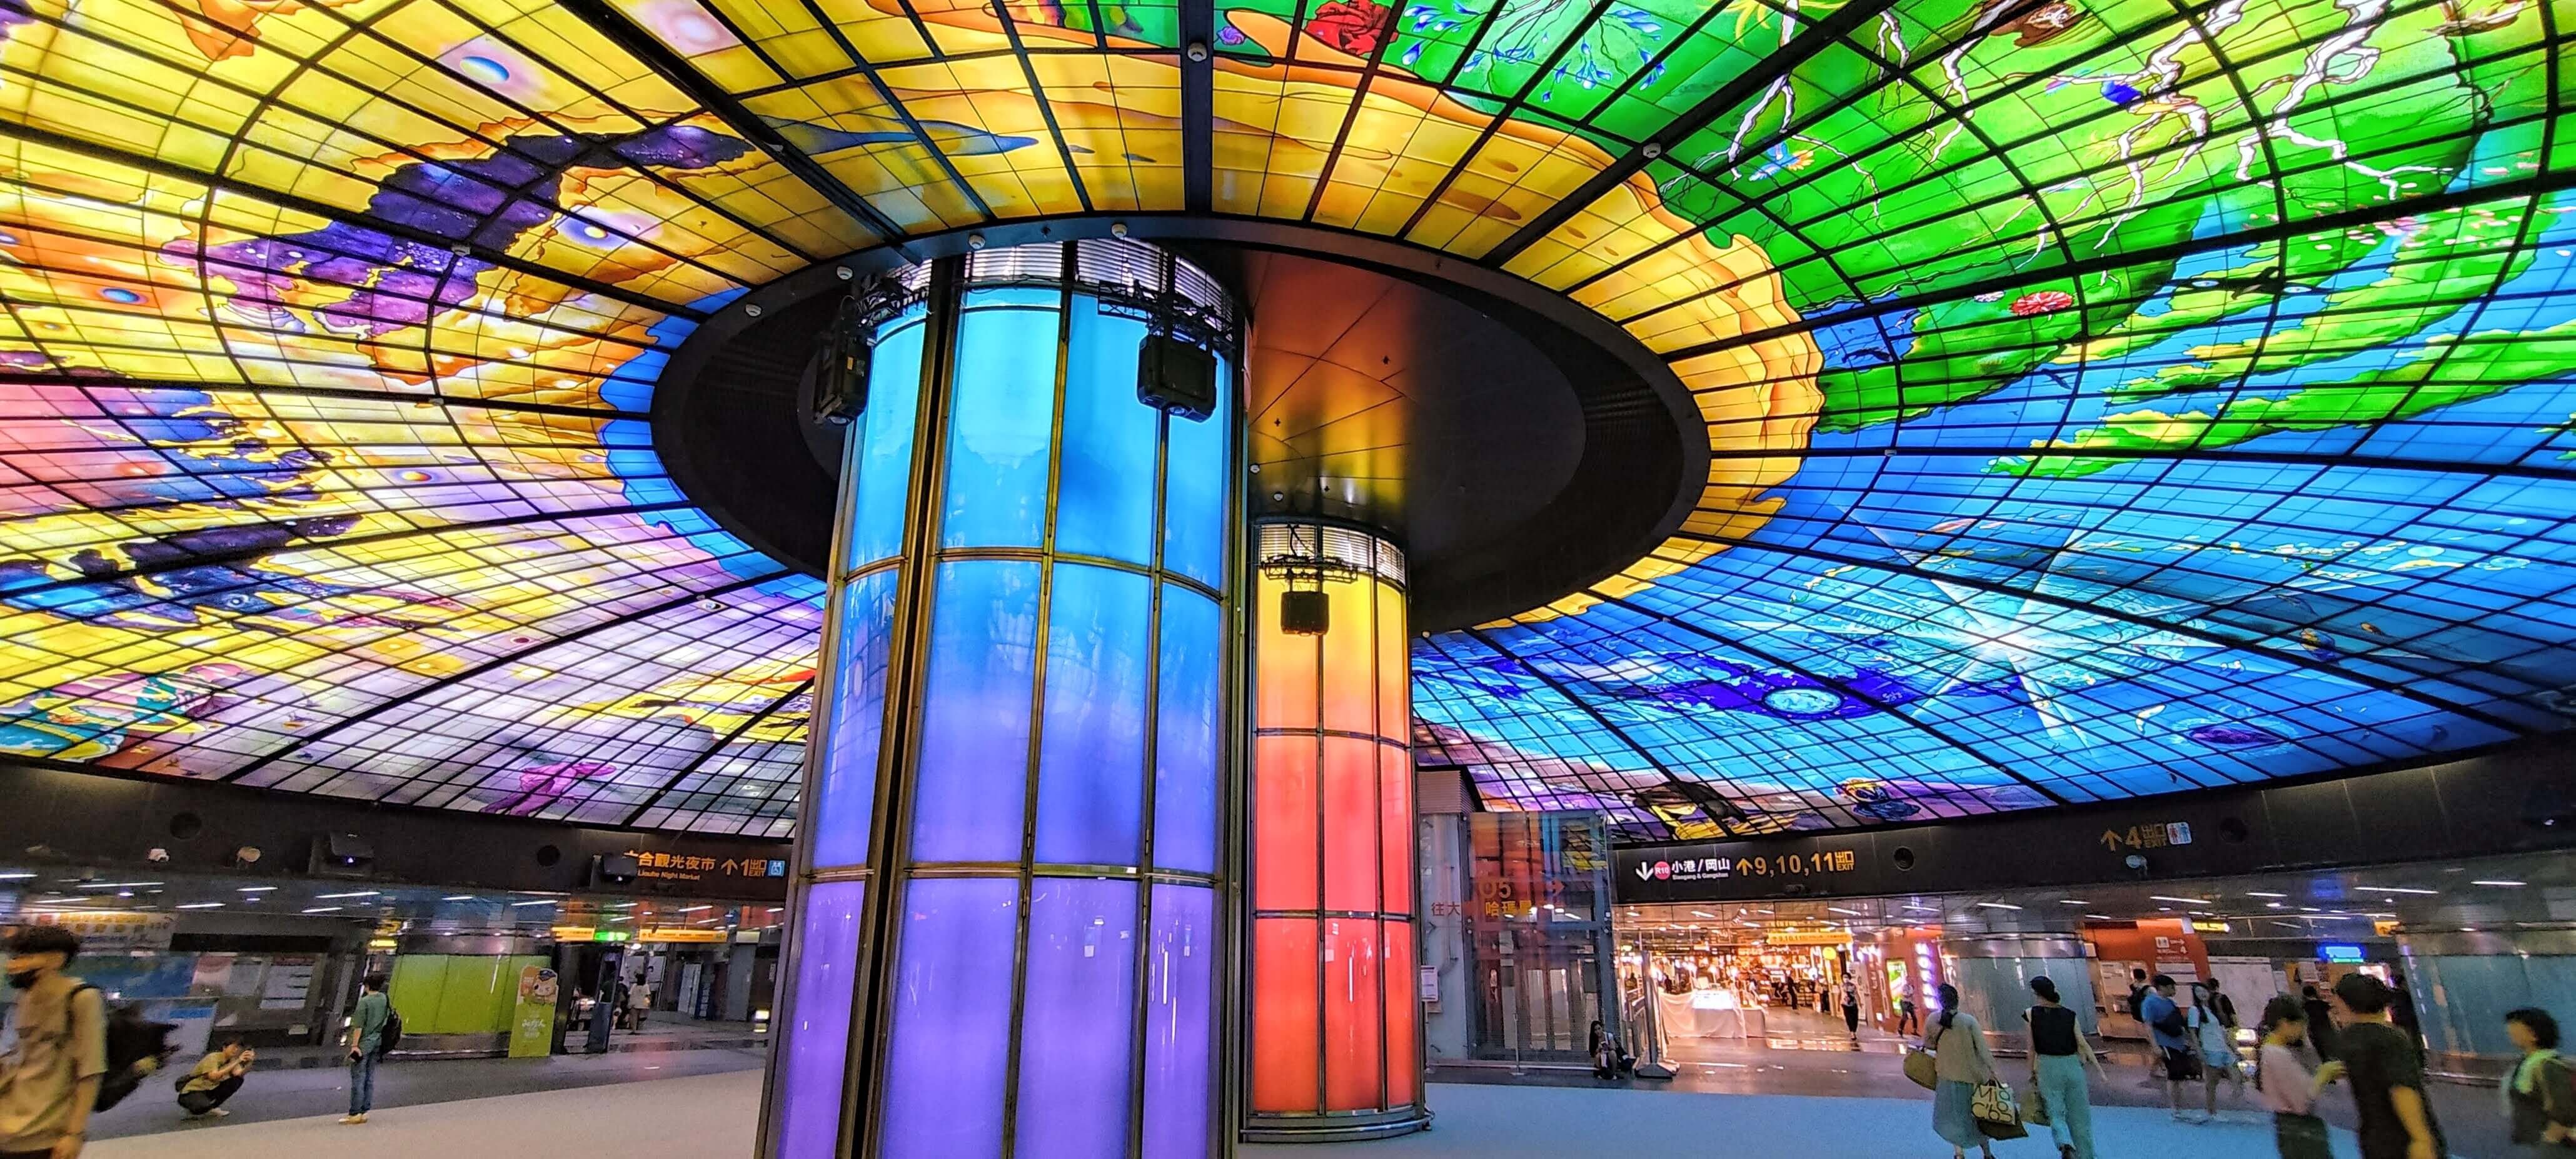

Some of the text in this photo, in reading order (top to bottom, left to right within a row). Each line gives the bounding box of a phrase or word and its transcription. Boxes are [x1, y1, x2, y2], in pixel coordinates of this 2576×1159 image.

[2125, 826, 2142, 849] 4
[2141, 823, 2166, 839] 出口
[1834, 851, 1854, 863] 出口
[740, 859, 750, 876] 1
[750, 859, 768, 870] 出口
[1837, 863, 1854, 871] EXIT
